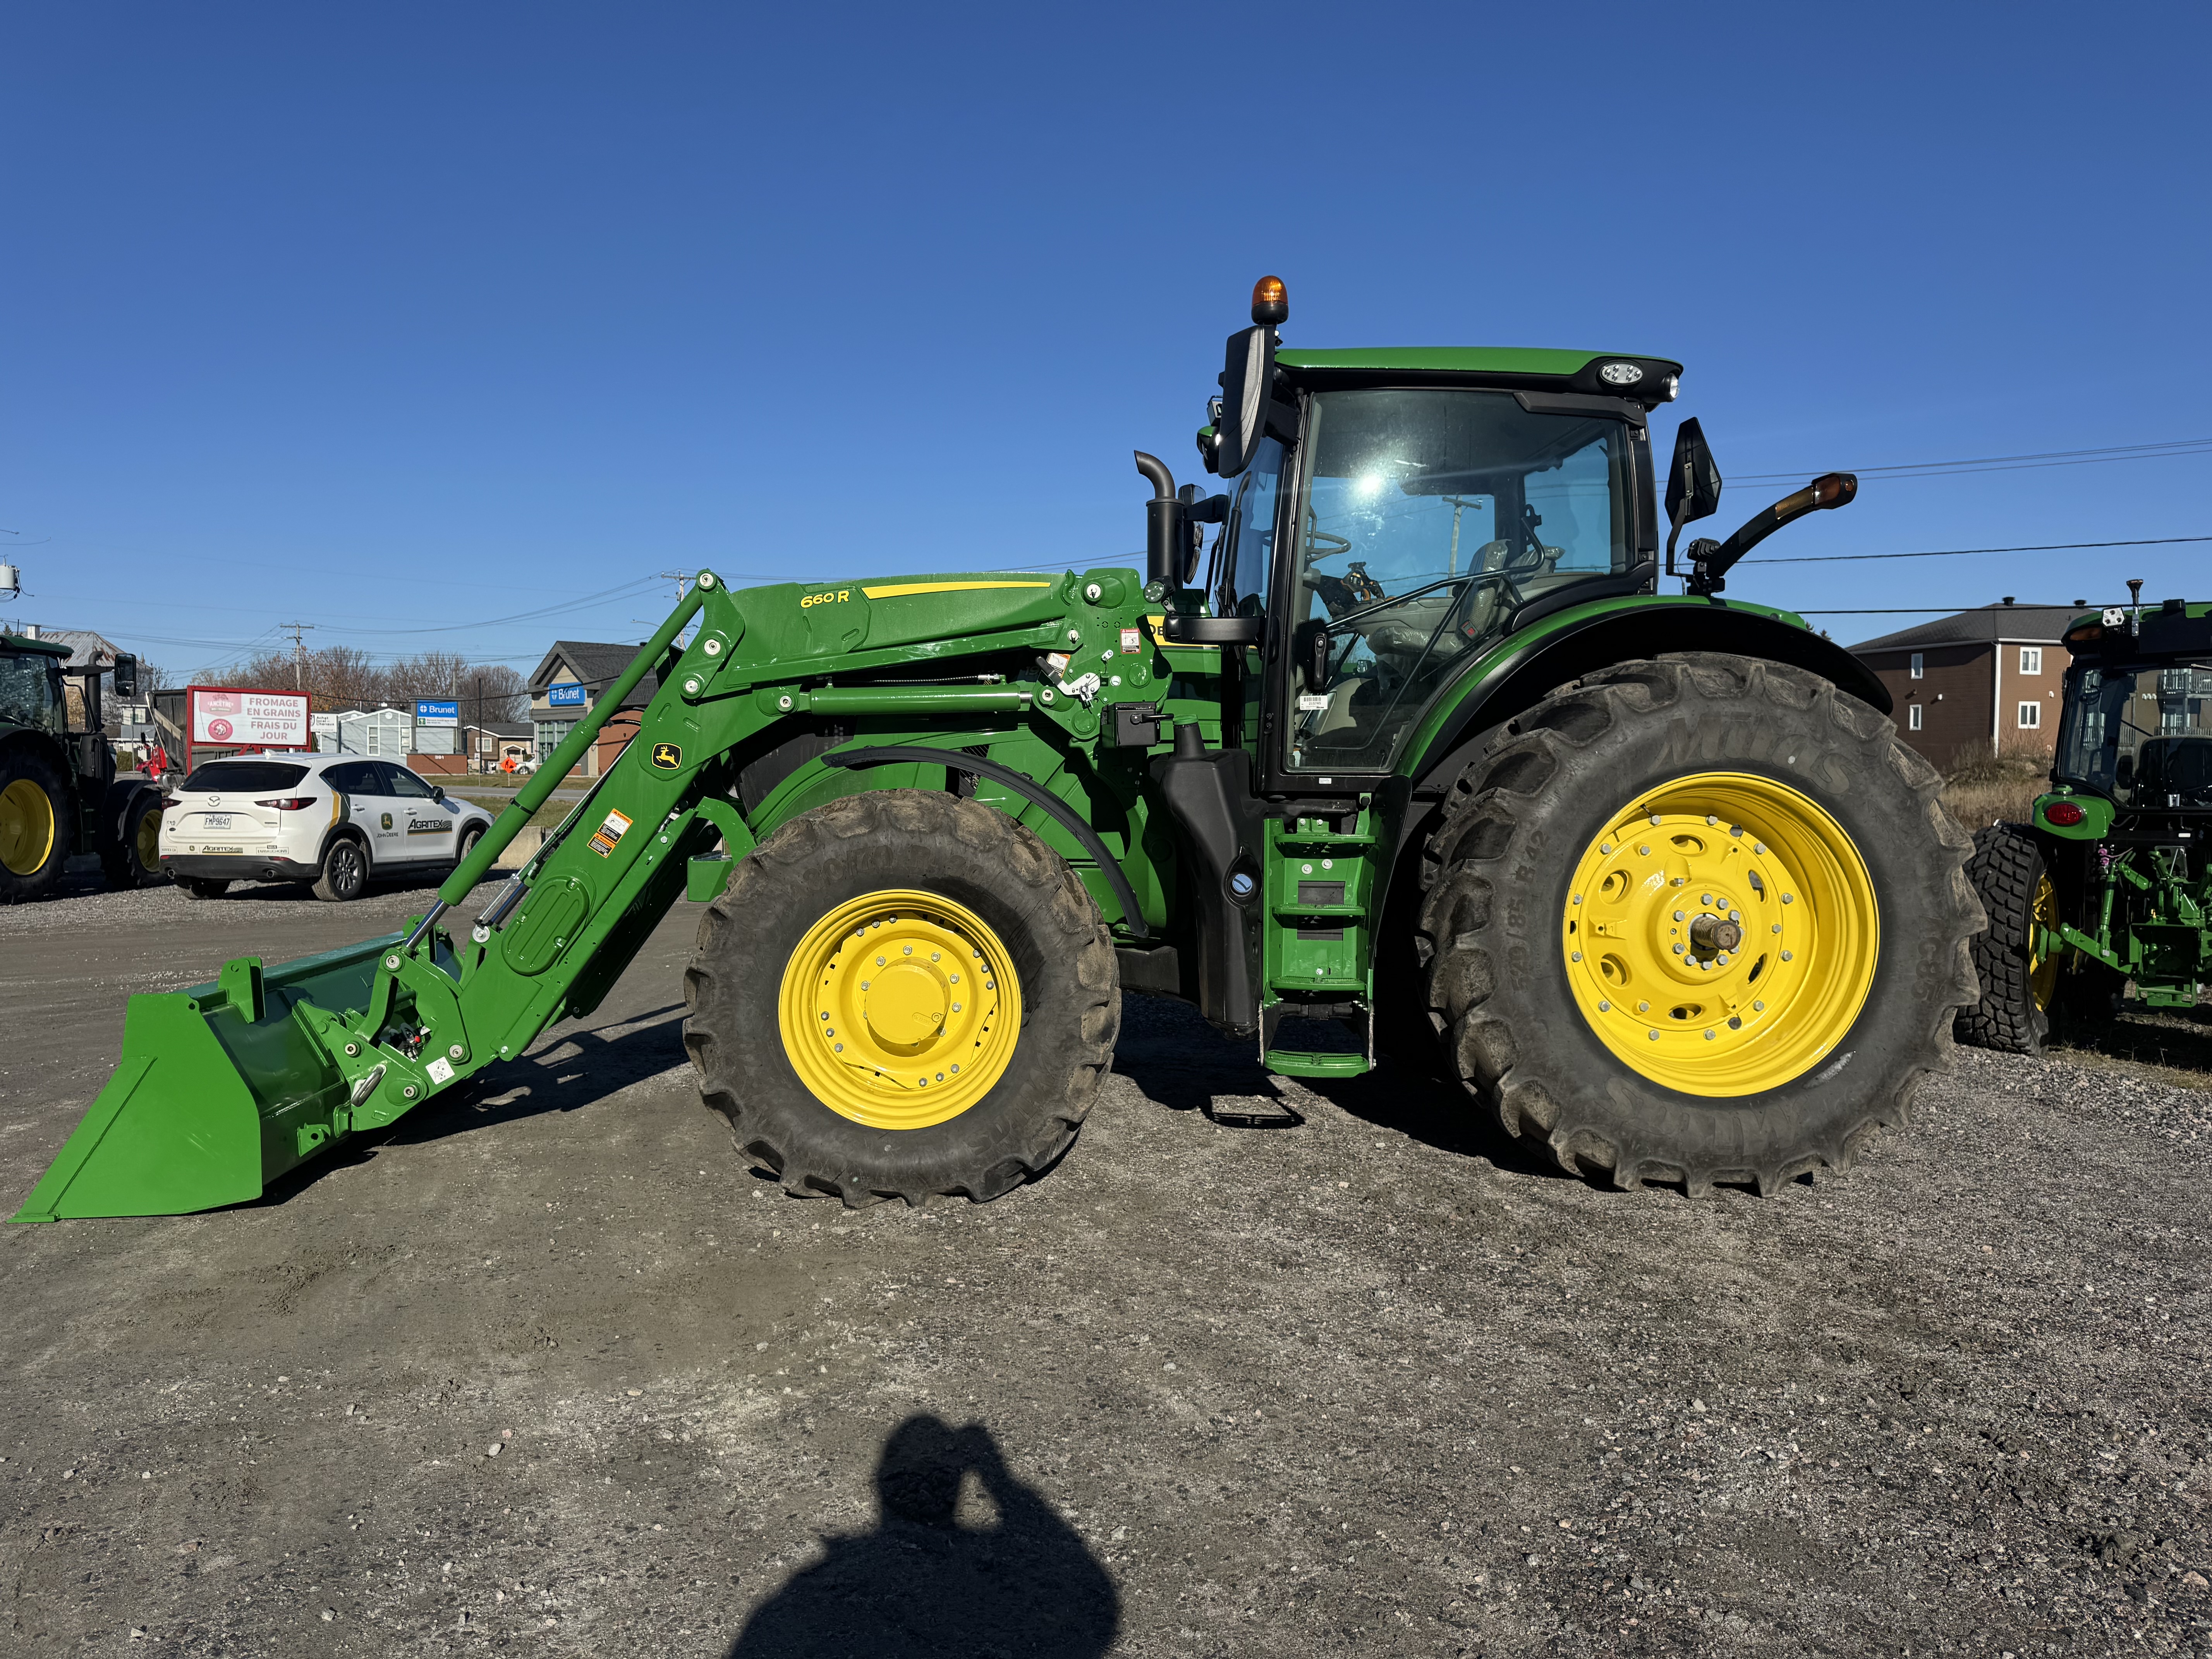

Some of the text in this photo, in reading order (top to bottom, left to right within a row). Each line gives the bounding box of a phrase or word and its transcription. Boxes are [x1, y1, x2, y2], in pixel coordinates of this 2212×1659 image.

[800, 590, 850, 608] 660 R
[558, 688, 579, 700] Brunet
[249, 698, 298, 707] FROMAGE
[263, 709, 301, 717] GRAINS
[251, 721, 280, 730] FRAIS
[260, 732, 288, 740] JOUR
[1646, 711, 1861, 793] Mitas
[205, 817, 230, 826] FMP9647
[408, 819, 443, 829] AGRITEX
